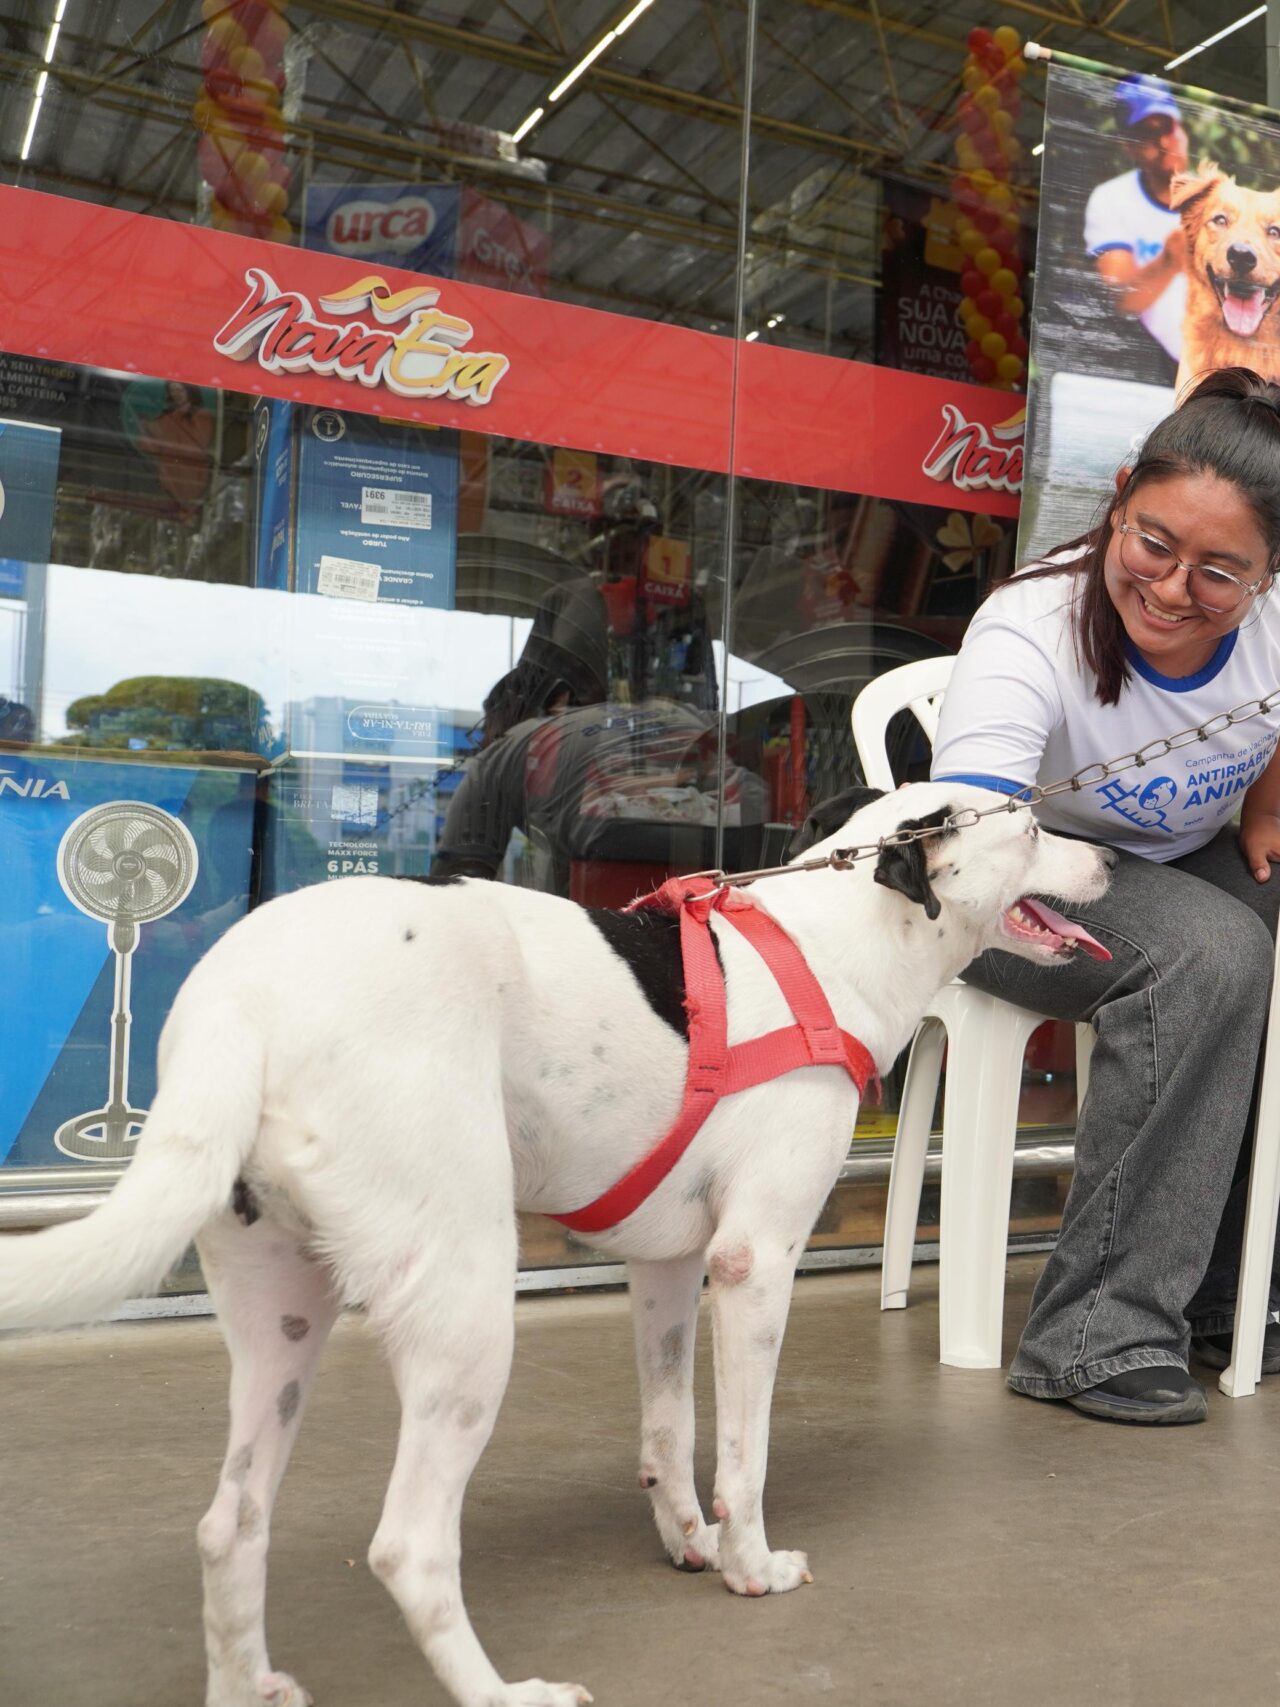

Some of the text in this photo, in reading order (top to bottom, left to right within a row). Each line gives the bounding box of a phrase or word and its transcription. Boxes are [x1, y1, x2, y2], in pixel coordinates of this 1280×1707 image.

[332, 206, 430, 245] urca
[898, 297, 948, 325] SUA
[899, 320, 966, 352] NOVA
[8, 384, 66, 402] CARTEIRA
[350, 471, 403, 482] SUPERSEGURO
[568, 469, 582, 489] 2
[365, 490, 385, 500] 9391
[552, 498, 594, 512] CAIXA
[362, 540, 387, 548] TURBO
[662, 556, 672, 575] 1
[644, 582, 684, 598] CAIXA
[1186, 752, 1235, 768] Campanha
[1238, 748, 1248, 758] de
[0, 776, 70, 800] NIA
[327, 858, 379, 873] 6 PÁS
